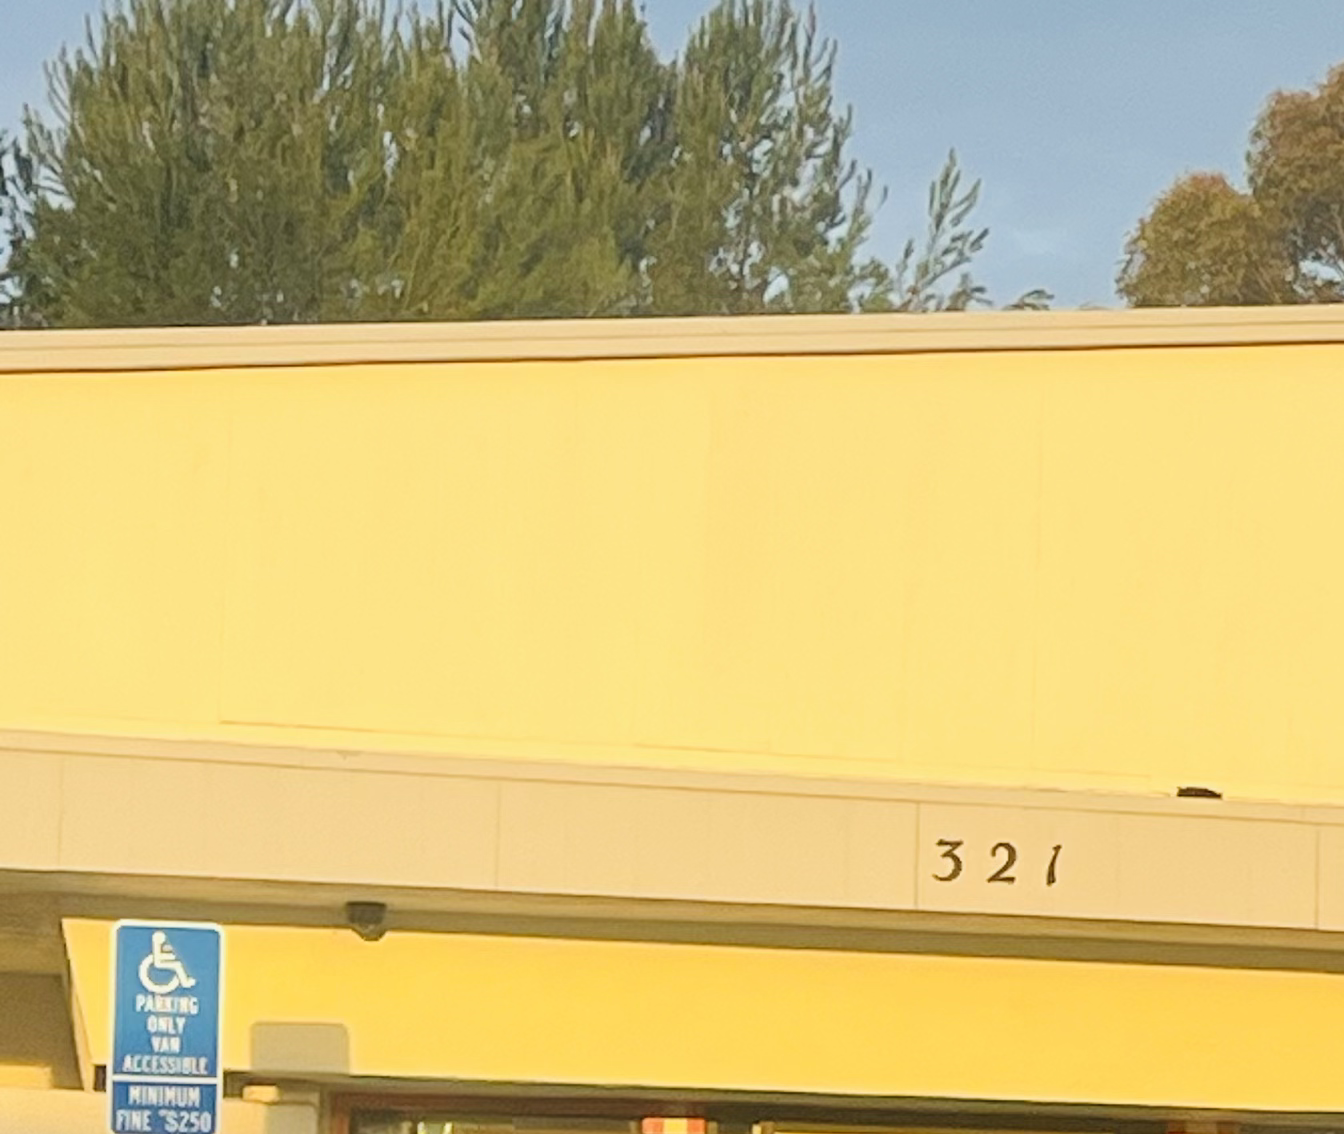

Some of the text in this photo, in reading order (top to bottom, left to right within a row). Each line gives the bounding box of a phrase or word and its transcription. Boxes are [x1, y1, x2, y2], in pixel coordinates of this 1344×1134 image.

[931, 838, 1063, 887] 321
[134, 993, 199, 1014] PARKING
[146, 1014, 186, 1034] ONLY
[150, 1035, 181, 1053] VAN
[121, 1054, 209, 1075] ACCESSIBLE
[127, 1084, 201, 1107] MINIMUM
[115, 1108, 212, 1134] FINE $250
